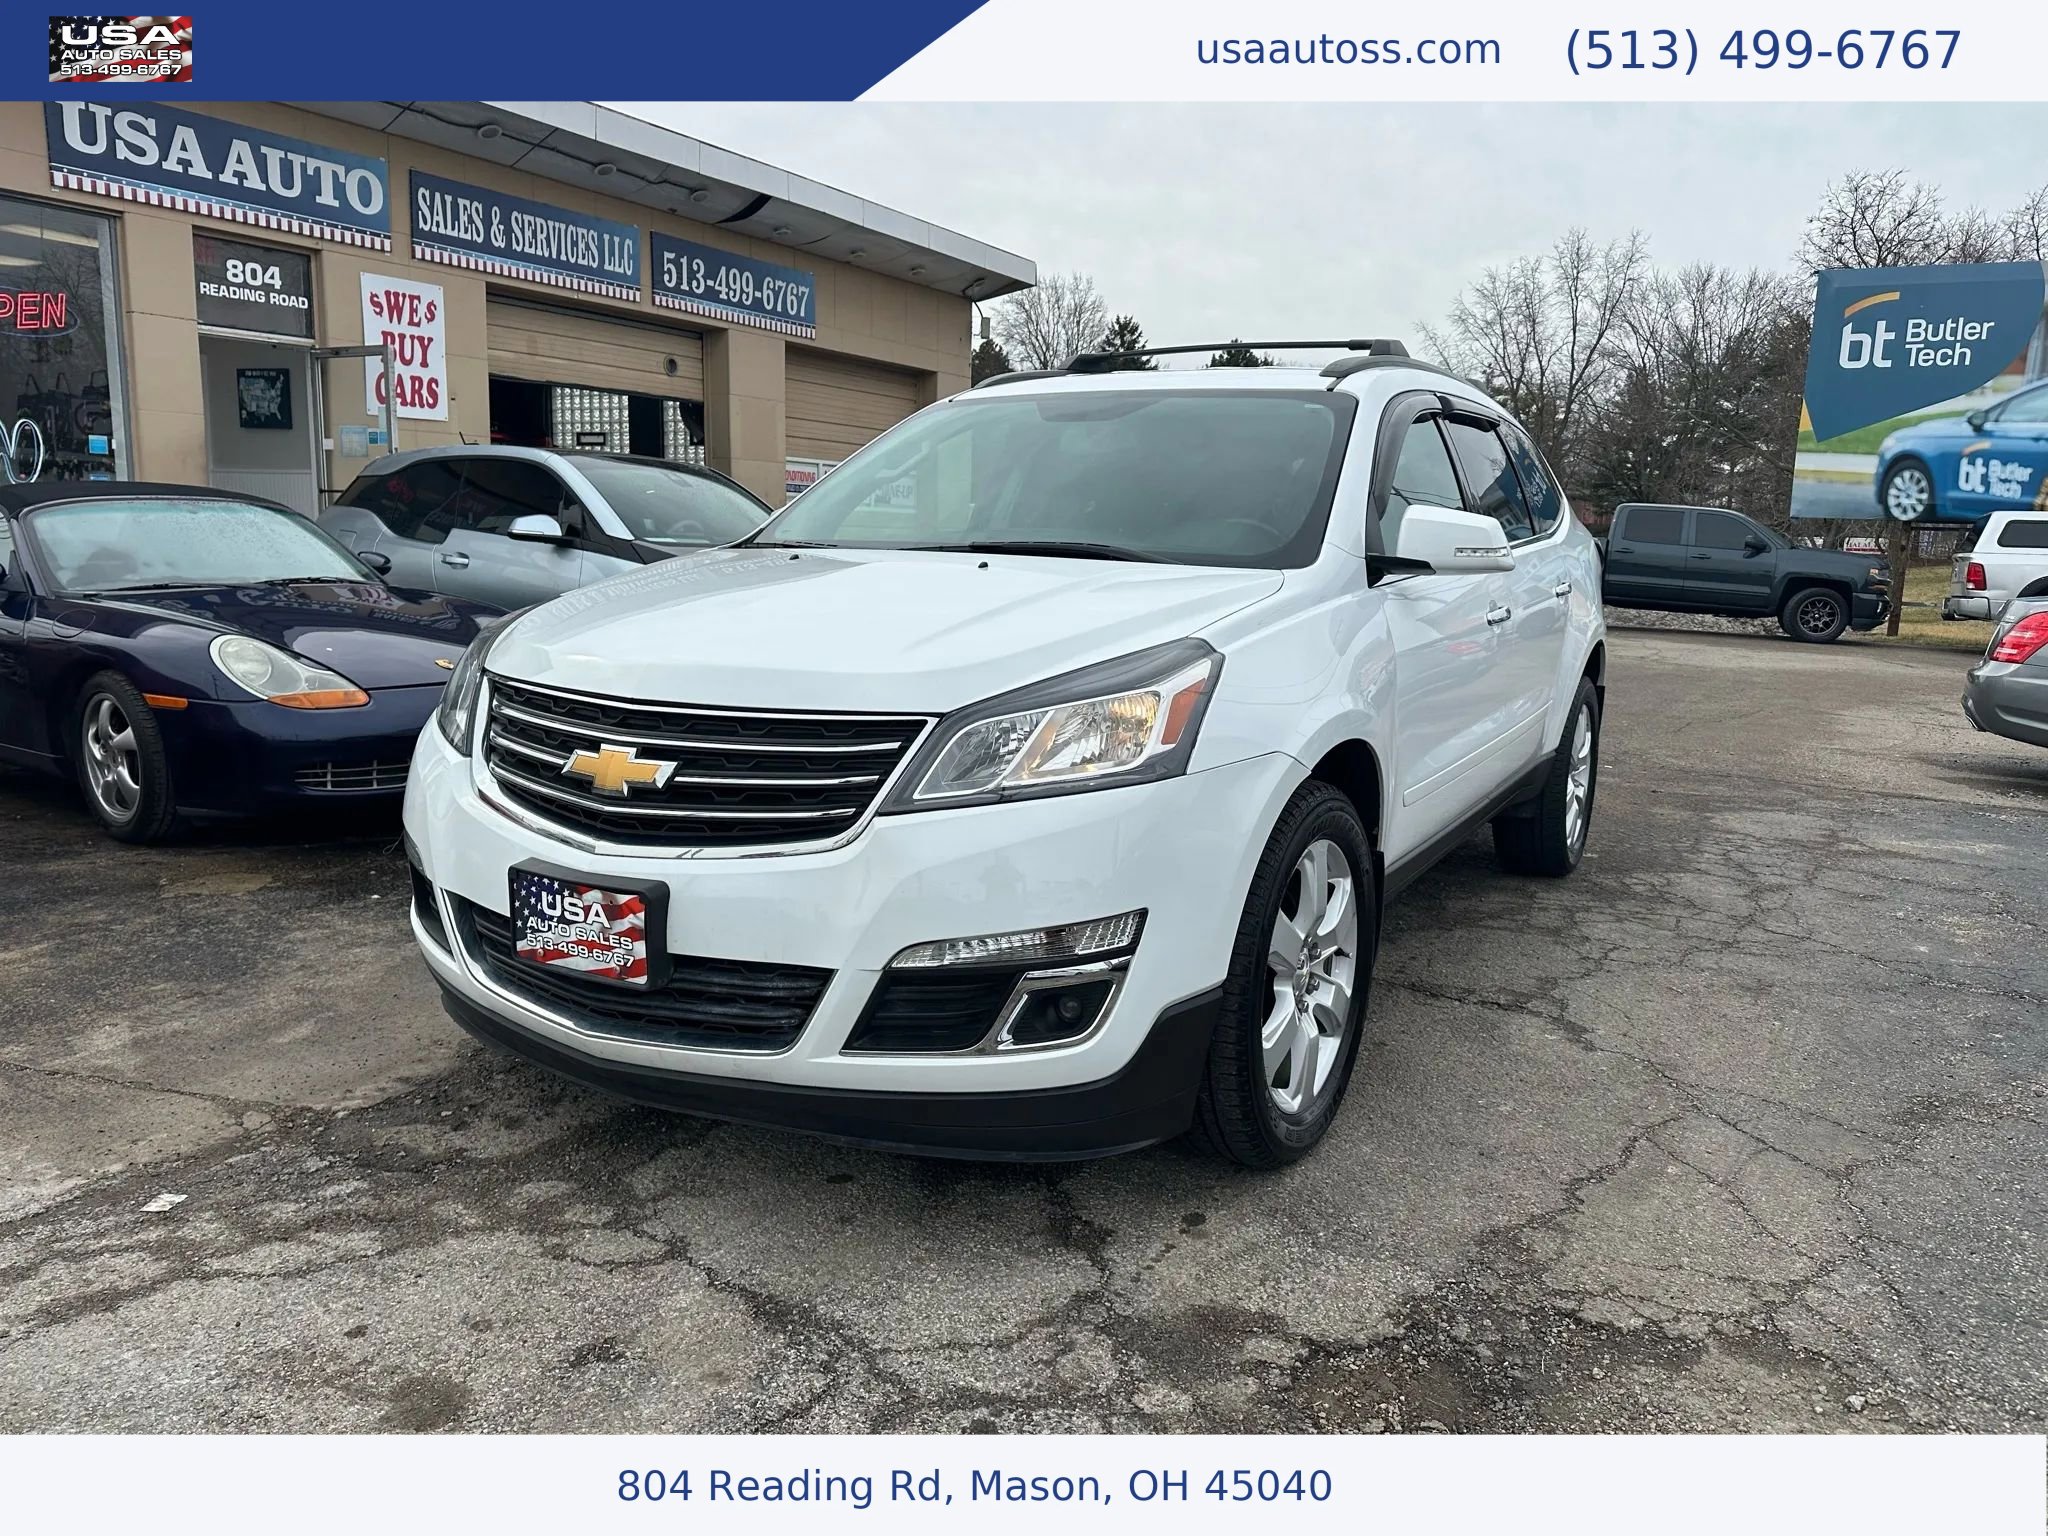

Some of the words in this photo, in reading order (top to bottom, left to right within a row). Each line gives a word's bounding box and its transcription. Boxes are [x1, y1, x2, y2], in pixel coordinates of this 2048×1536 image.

[54, 101, 212, 180] USA
[219, 137, 385, 216] AUTO
[417, 186, 484, 244] SALES
[490, 206, 506, 249] &
[511, 210, 599, 269] SERVICES
[603, 233, 634, 276] LLC
[226, 259, 282, 290] 804
[663, 250, 810, 318] 513-499-6767
[199, 281, 266, 304] READING
[269, 292, 309, 310] ROAD
[1839, 321, 1896, 369] bt
[1905, 317, 1996, 343] Butler
[1904, 342, 1972, 367] Tech
[375, 371, 440, 410] CARS
[1958, 456, 1987, 493] bt
[541, 890, 611, 929] USA
[526, 916, 571, 938] AUTO
[575, 926, 633, 950] SALES
[526, 933, 635, 968] 513-499-6767
